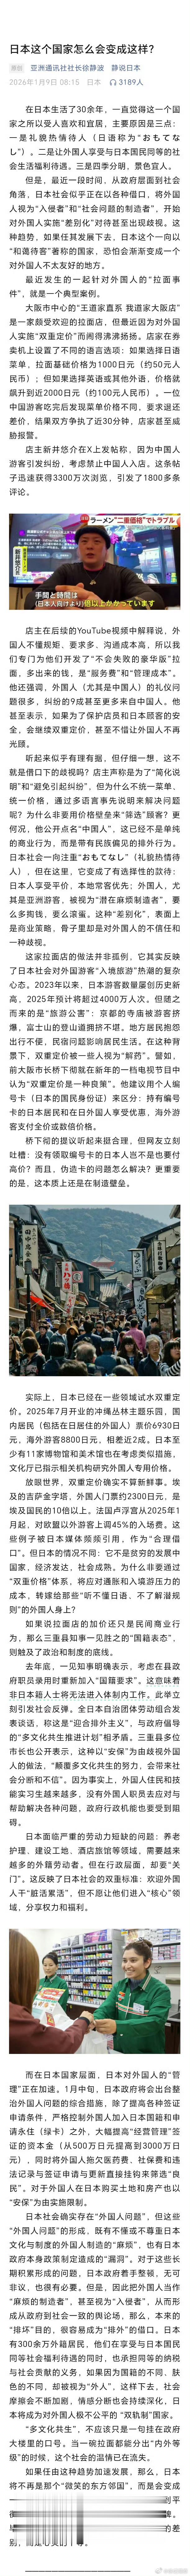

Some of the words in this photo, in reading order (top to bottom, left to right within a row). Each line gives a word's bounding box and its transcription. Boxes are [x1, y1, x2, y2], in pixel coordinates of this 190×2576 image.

[11, 44, 154, 54] 日本这个国家怎么会变成这样？
[10, 120, 174, 128] 家之所以受人喜欢和宜居，主要原因是三点：
[10, 247, 180, 255] “和蔼待客”著称的国家，恐怕会渐渐变成一个
[10, 417, 180, 425] 差价，结果双方争执了近30分钟，店家甚至威
[10, 1648, 112, 1656] 则触及了政治和制度的底线。
[9, 1847, 180, 1855] 护理、建设工地、酒店旅馆等领域，需要越来
[10, 2085, 180, 2093] 理”正在加速。1月中旬，日本政府将会出台整
[10, 2227, 180, 2235] “外国人问题”的形成，既有不懂或不尊重日本
